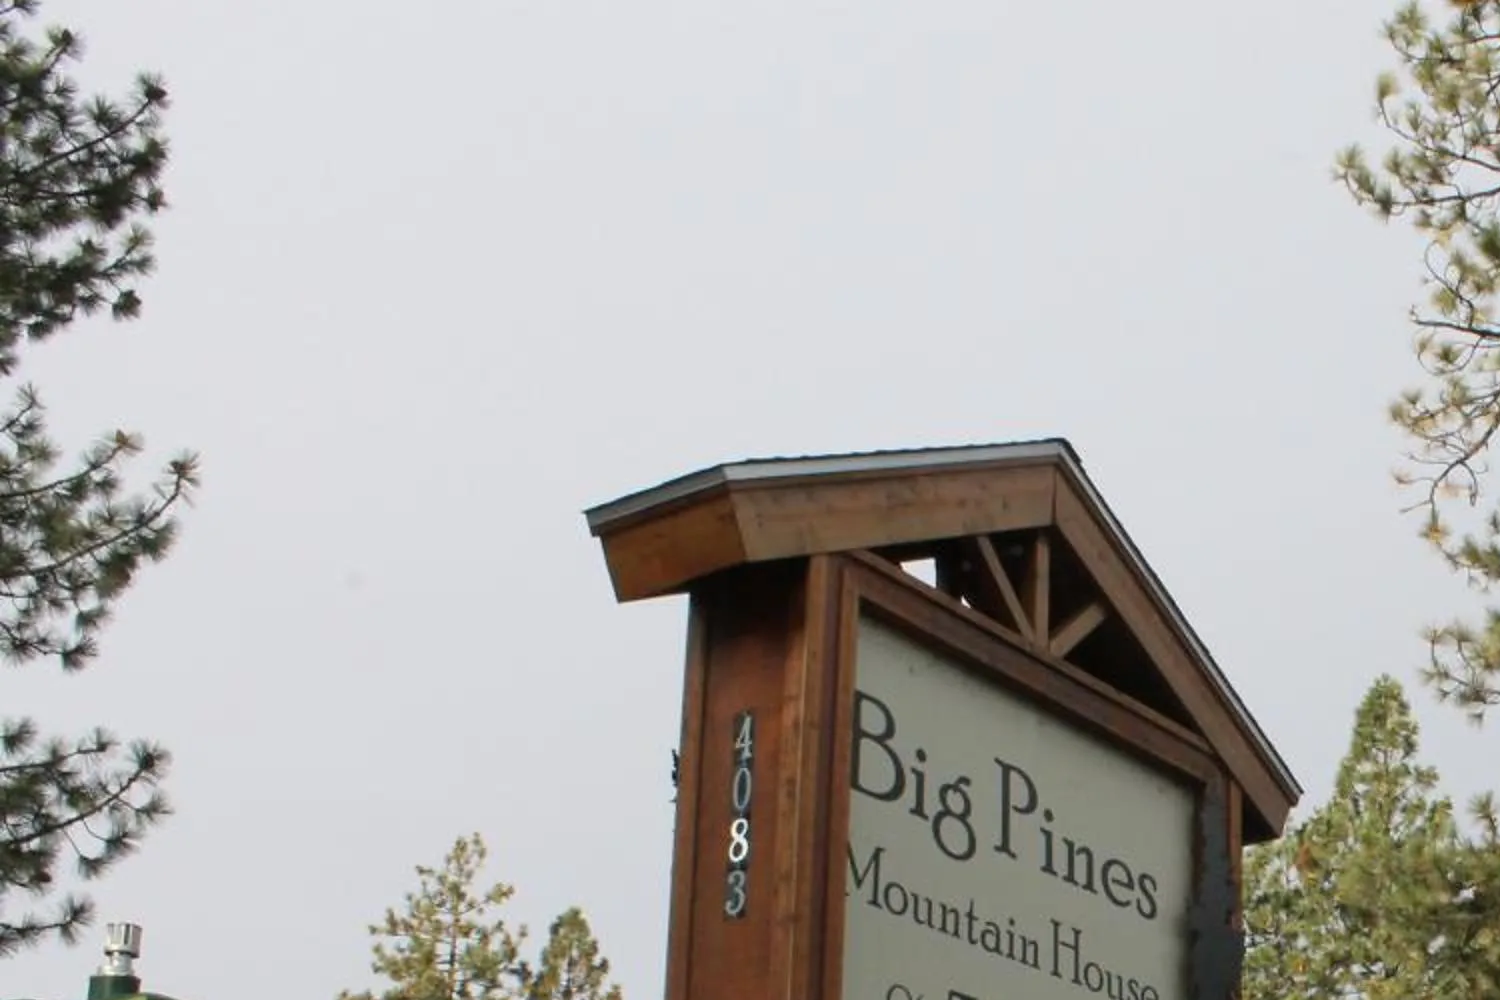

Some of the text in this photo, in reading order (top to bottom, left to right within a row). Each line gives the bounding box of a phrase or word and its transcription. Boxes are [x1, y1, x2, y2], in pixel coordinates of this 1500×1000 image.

[725, 714, 752, 916] 4083
[845, 840, 1040, 970] Mountain
[850, 690, 1158, 920] Big Pines
